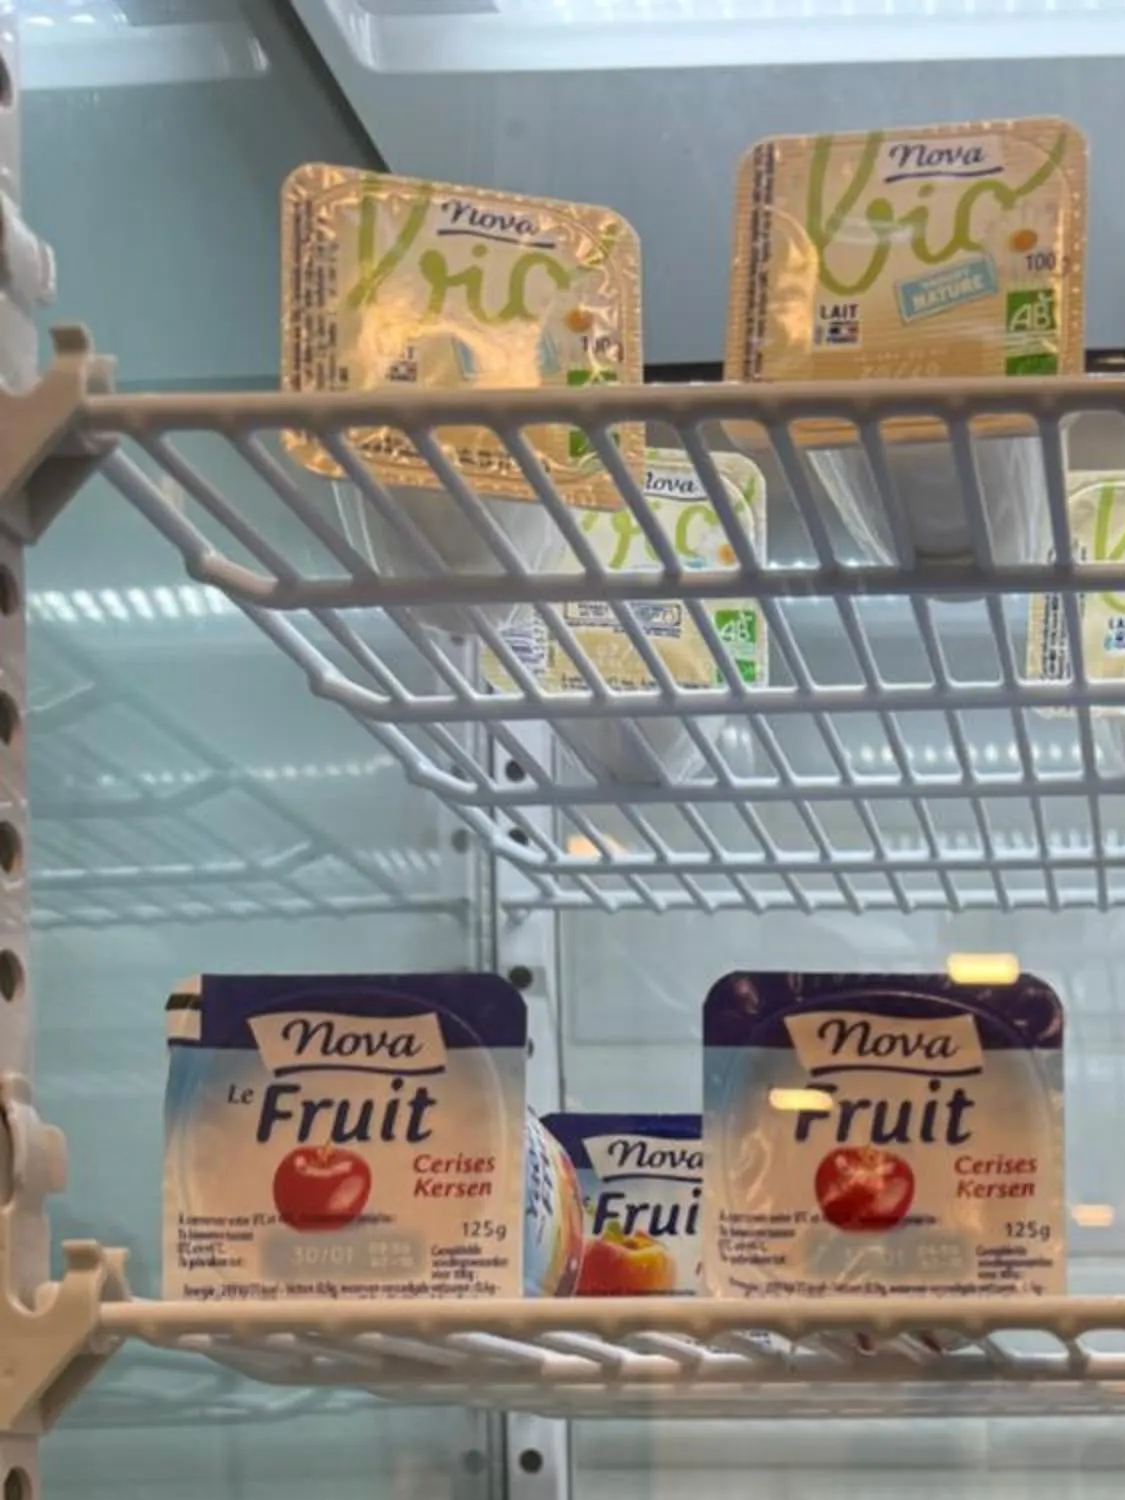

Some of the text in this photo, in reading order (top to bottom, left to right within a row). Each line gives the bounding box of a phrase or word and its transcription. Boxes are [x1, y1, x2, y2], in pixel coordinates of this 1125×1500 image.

[888, 143, 984, 166] Nova
[442, 199, 540, 236] Nova
[820, 303, 858, 320] LAIT
[1010, 300, 1050, 331] AB
[281, 1019, 423, 1058] Nova
[818, 1019, 959, 1059] Nova
[228, 1078, 437, 1143] Le Fruit
[795, 1079, 975, 1143] Fruit
[413, 1153, 496, 1175] Cerises
[608, 1140, 703, 1170] Nova
[954, 1155, 1038, 1176] Cerises
[413, 1177, 493, 1199] Kersen
[956, 1179, 1036, 1200] Kersen
[592, 1187, 703, 1236] Frui
[462, 1220, 507, 1242] 125g
[1005, 1221, 1051, 1242] 125g
